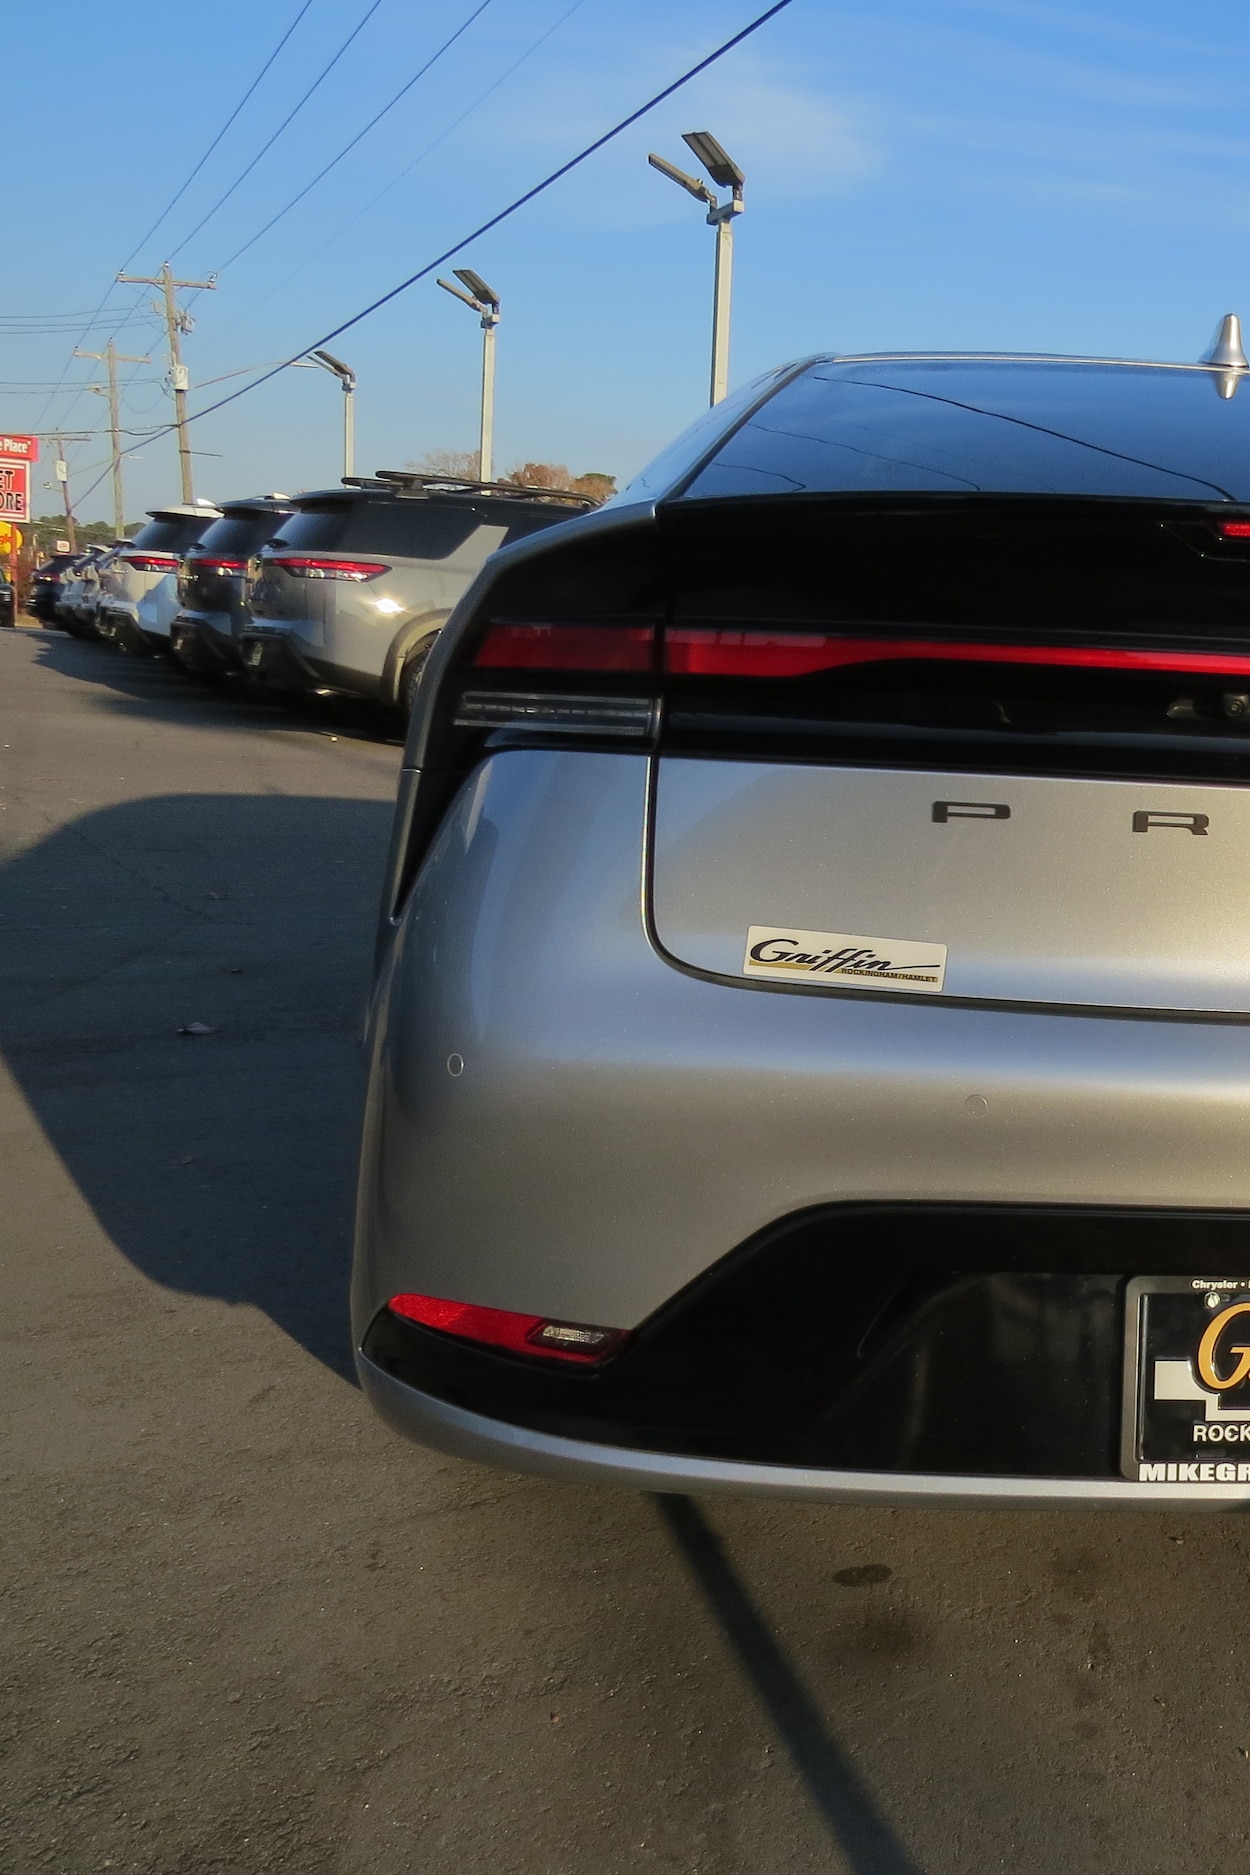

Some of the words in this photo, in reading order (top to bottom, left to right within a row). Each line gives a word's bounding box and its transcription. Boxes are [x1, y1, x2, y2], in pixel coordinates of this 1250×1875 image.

[4, 438, 28, 454] Place
[750, 938, 940, 974] Griffin
[1191, 1279, 1238, 1290] Chrysler
